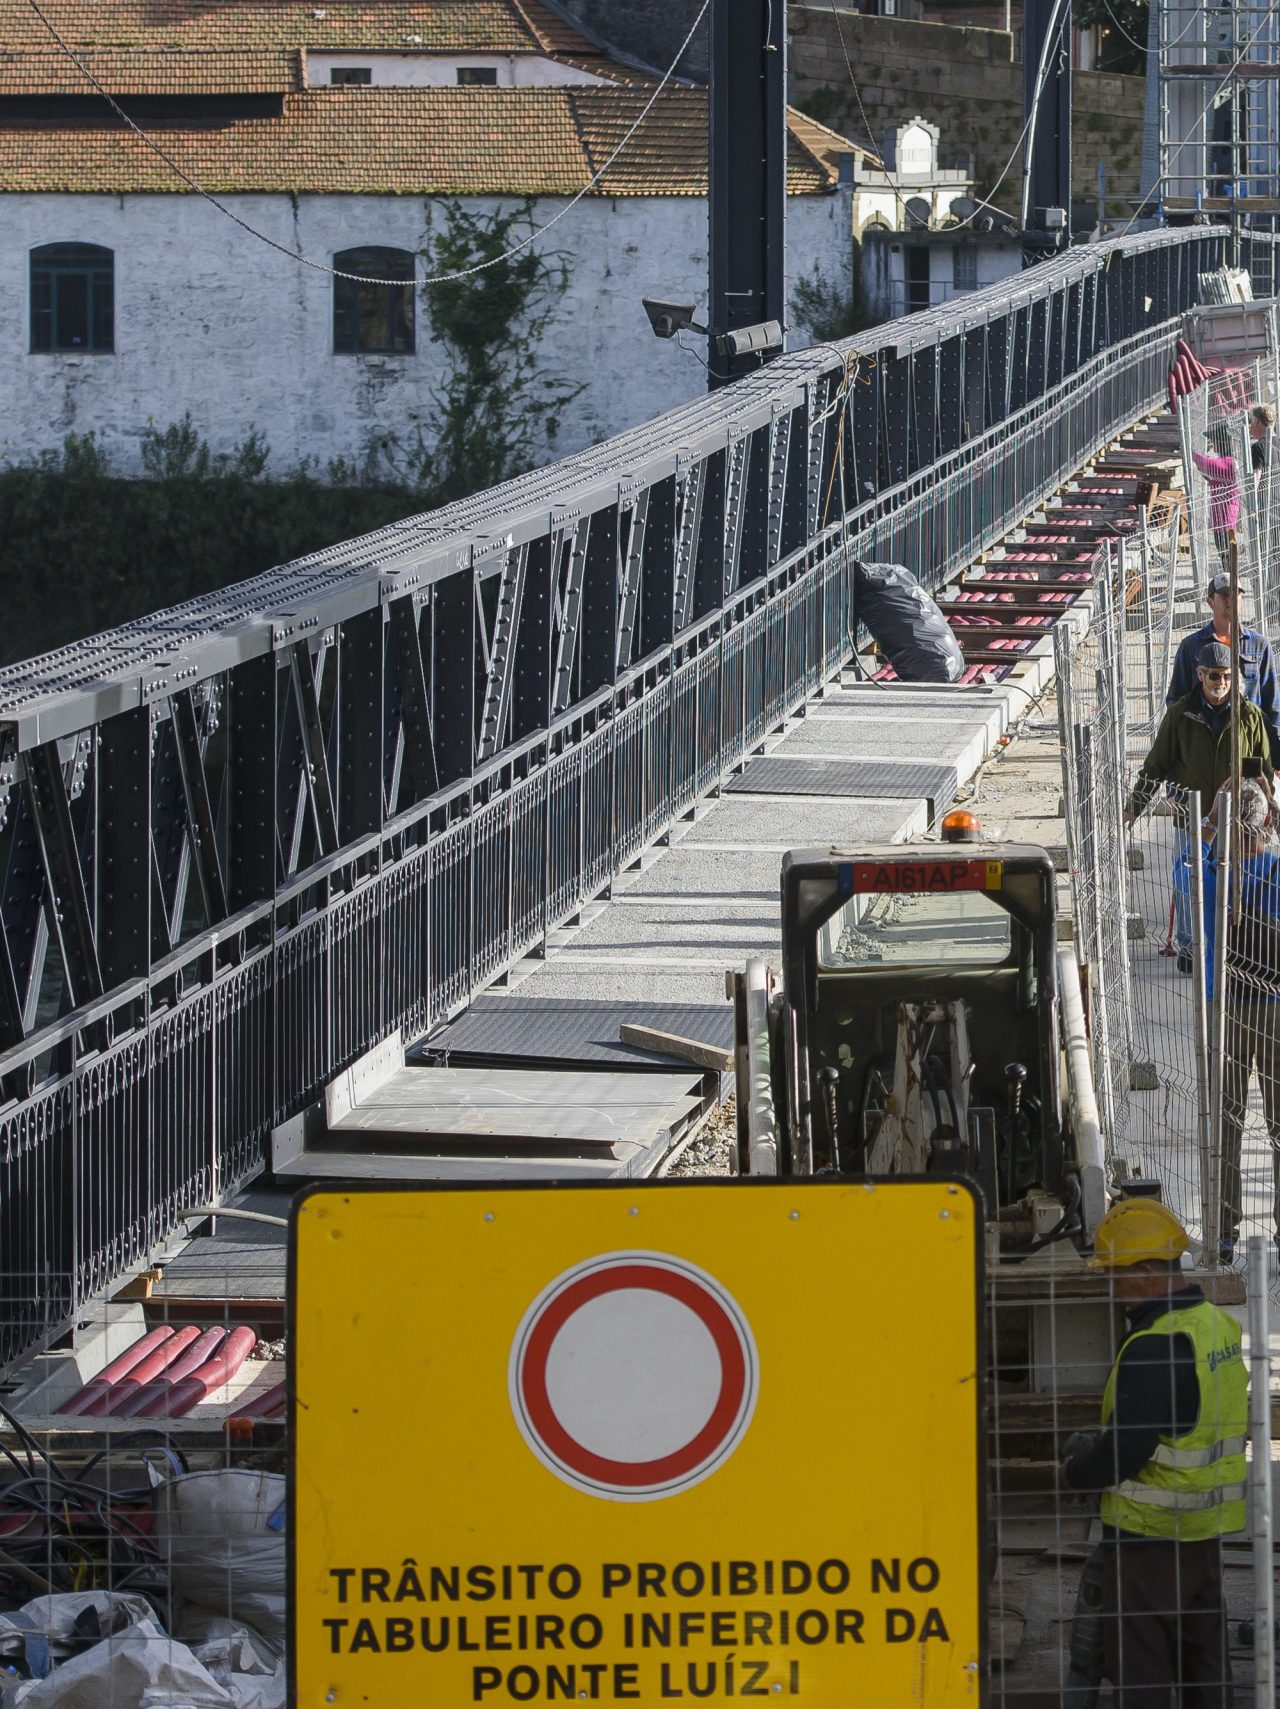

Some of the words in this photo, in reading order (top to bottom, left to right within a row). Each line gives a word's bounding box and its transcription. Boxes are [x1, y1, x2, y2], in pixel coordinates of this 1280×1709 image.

[329, 1558, 582, 1603] TRÂNSITO
[602, 1559, 850, 1599] PROIBIDO
[871, 1557, 941, 1593] NO
[322, 1613, 604, 1654] TABULEIRO
[624, 1608, 865, 1648] INFERIOR
[885, 1607, 950, 1644] DA
[472, 1663, 641, 1702] PONTE
[660, 1653, 770, 1699] LUÍZ
[789, 1660, 800, 1696] I
